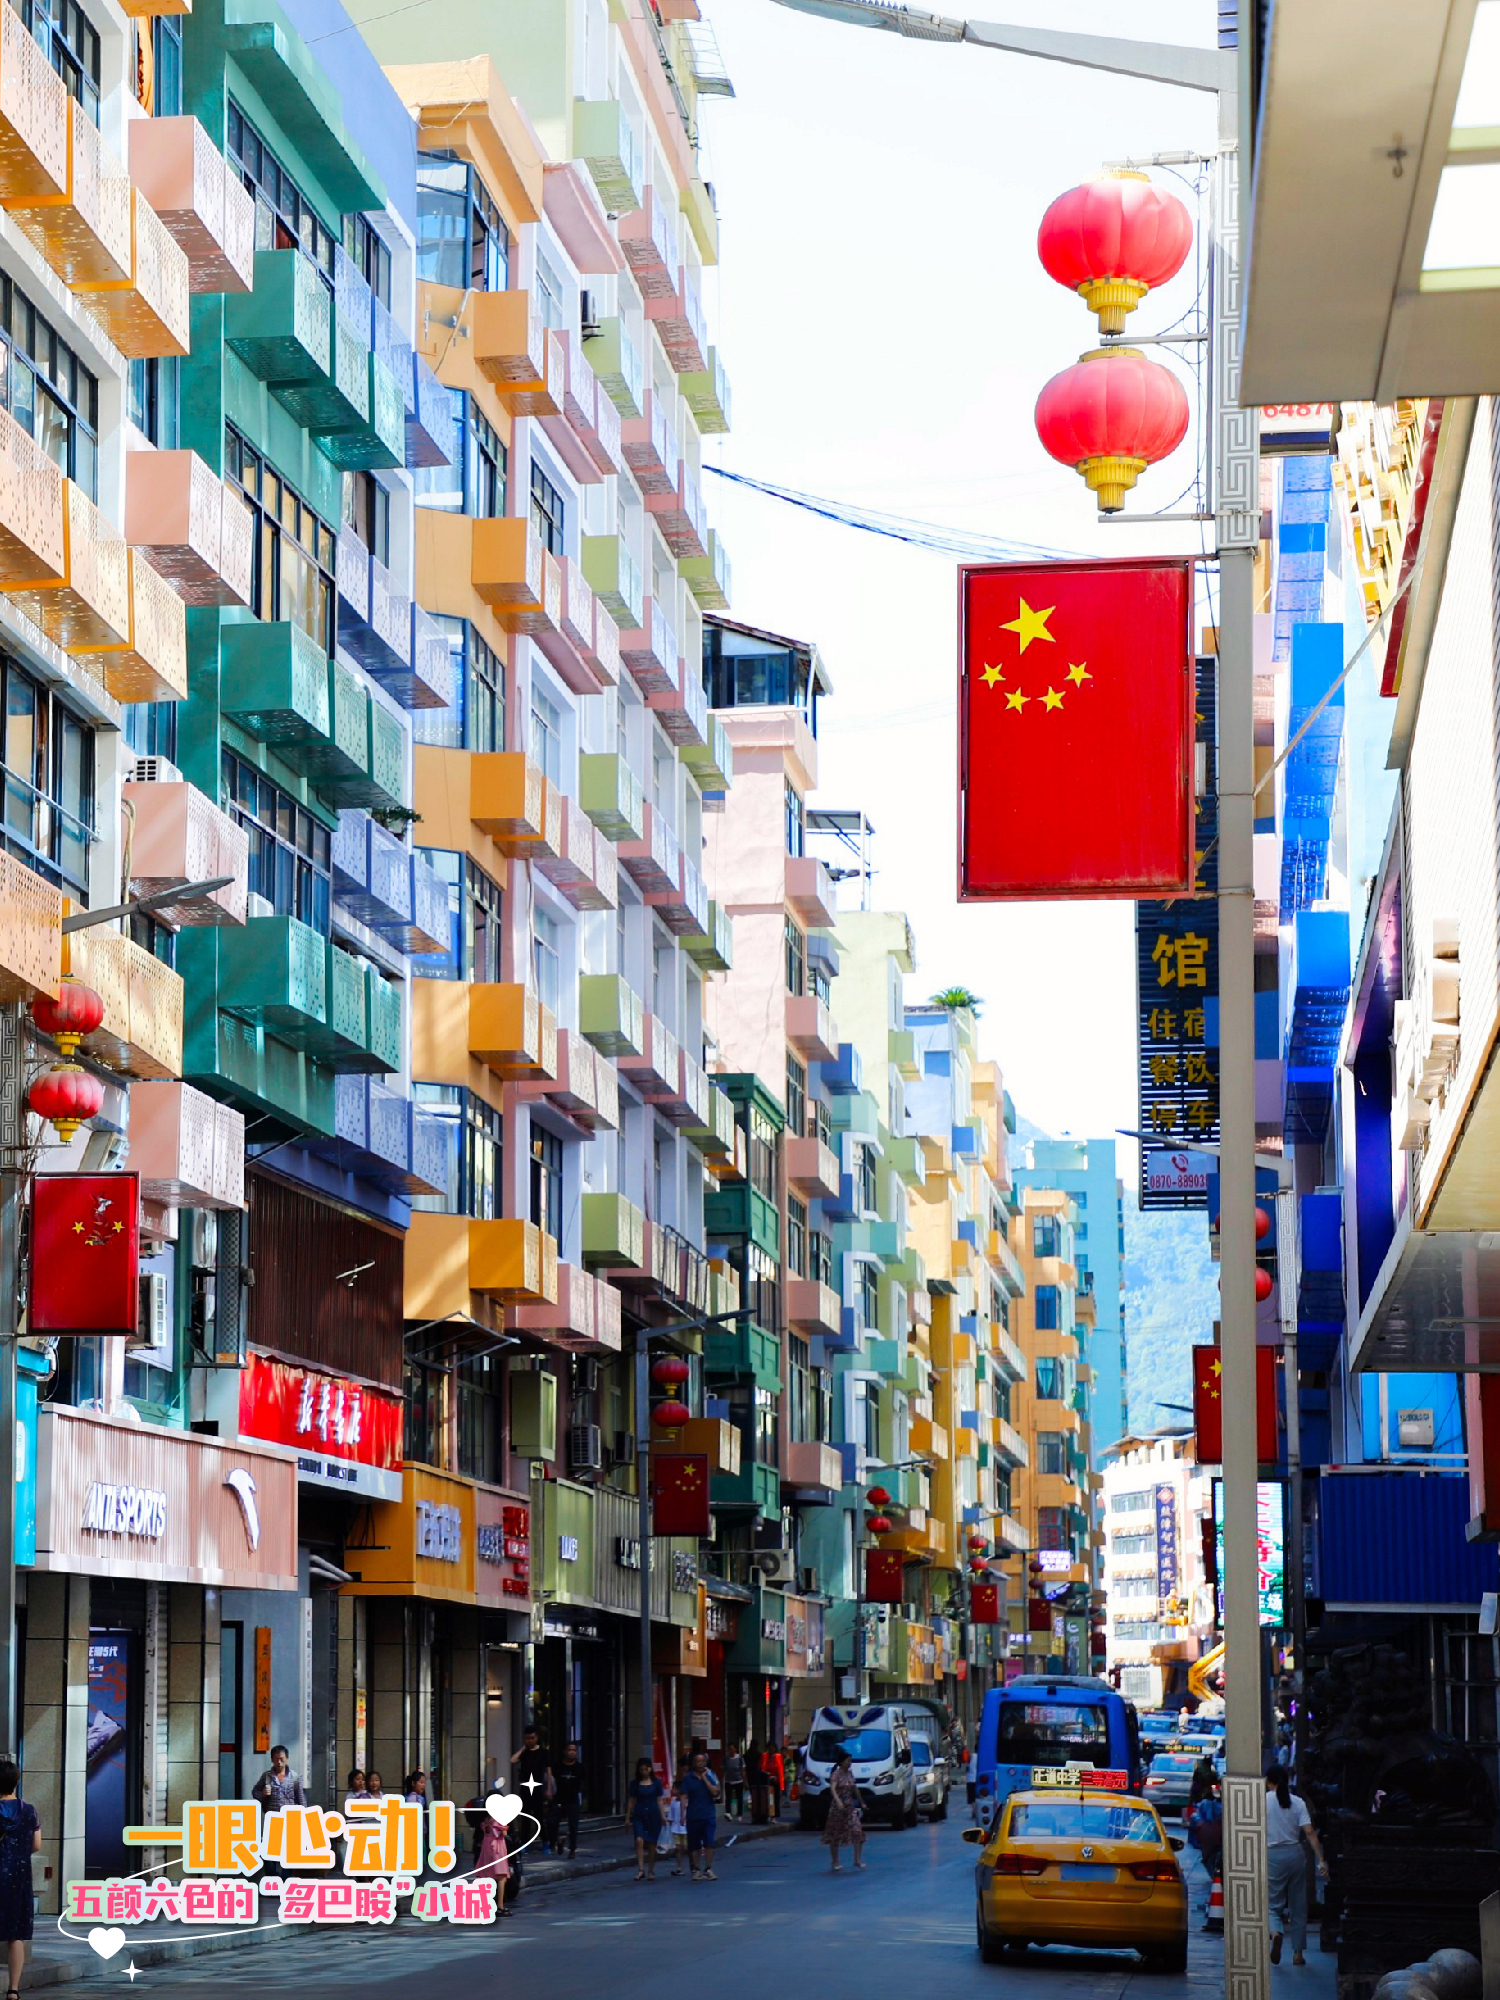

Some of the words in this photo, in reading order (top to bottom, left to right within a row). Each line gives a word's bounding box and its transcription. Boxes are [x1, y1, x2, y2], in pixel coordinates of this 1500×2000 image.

[1149, 1007, 1206, 1039] 住宿
[1150, 1053, 1215, 1083] 餐饮
[1150, 1100, 1215, 1129] 停车
[1150, 1174, 1208, 1188] 0870-88903
